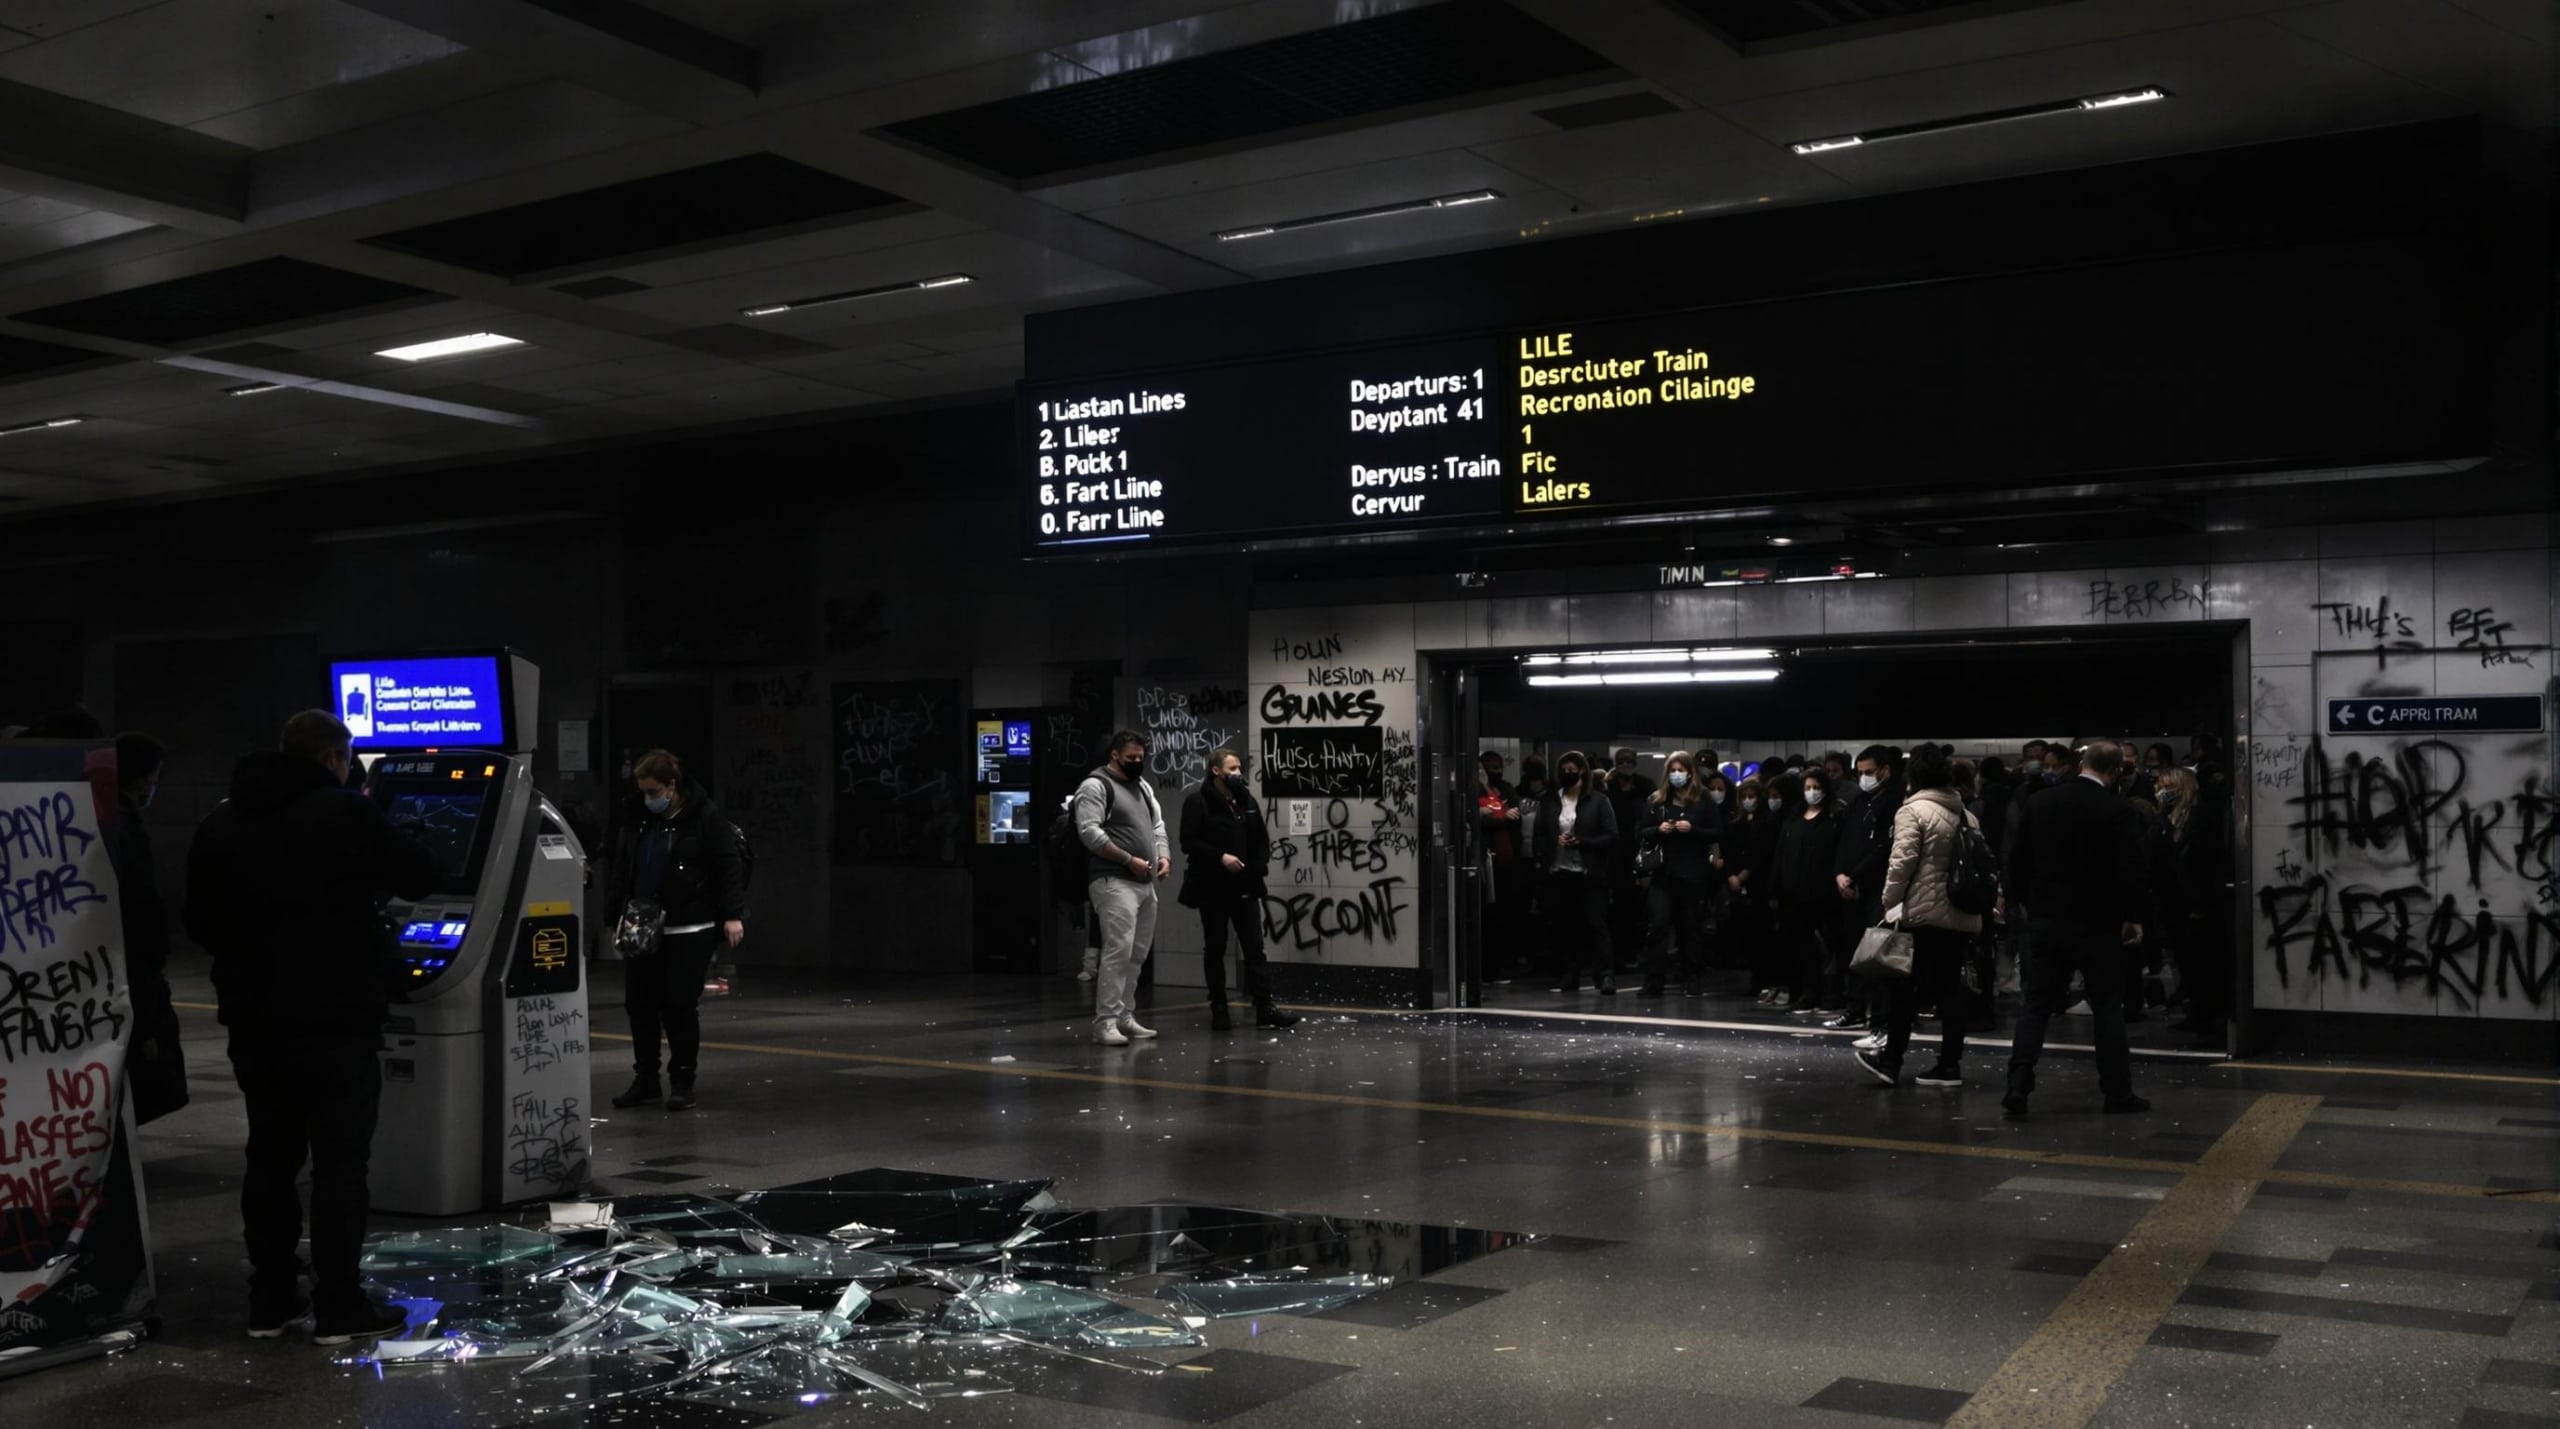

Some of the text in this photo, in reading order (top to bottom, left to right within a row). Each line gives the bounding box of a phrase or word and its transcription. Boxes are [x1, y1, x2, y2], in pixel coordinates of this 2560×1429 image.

[1521, 333, 1573, 359] LILE
[1653, 348, 1708, 373] Train
[1350, 368, 1484, 404] Departurs: 1
[1038, 401, 1049, 422] 1
[1128, 390, 1186, 415] Lines
[1350, 397, 1484, 433] Deyptant 41
[1038, 428, 1059, 450] 2.
[1521, 424, 1532, 445] 1
[1039, 455, 1060, 478] B.
[1117, 450, 1128, 471] 1
[1351, 464, 1427, 488] Deryus
[1443, 454, 1501, 479] Train
[1522, 451, 1557, 474] Fic
[1066, 481, 1110, 504] Fart
[1522, 478, 1591, 503] Lalers
[1351, 493, 1426, 516] Cervur
[1066, 510, 1112, 533] Farr
[2367, 705, 2385, 725] C
[2435, 707, 2477, 720] TRAM
